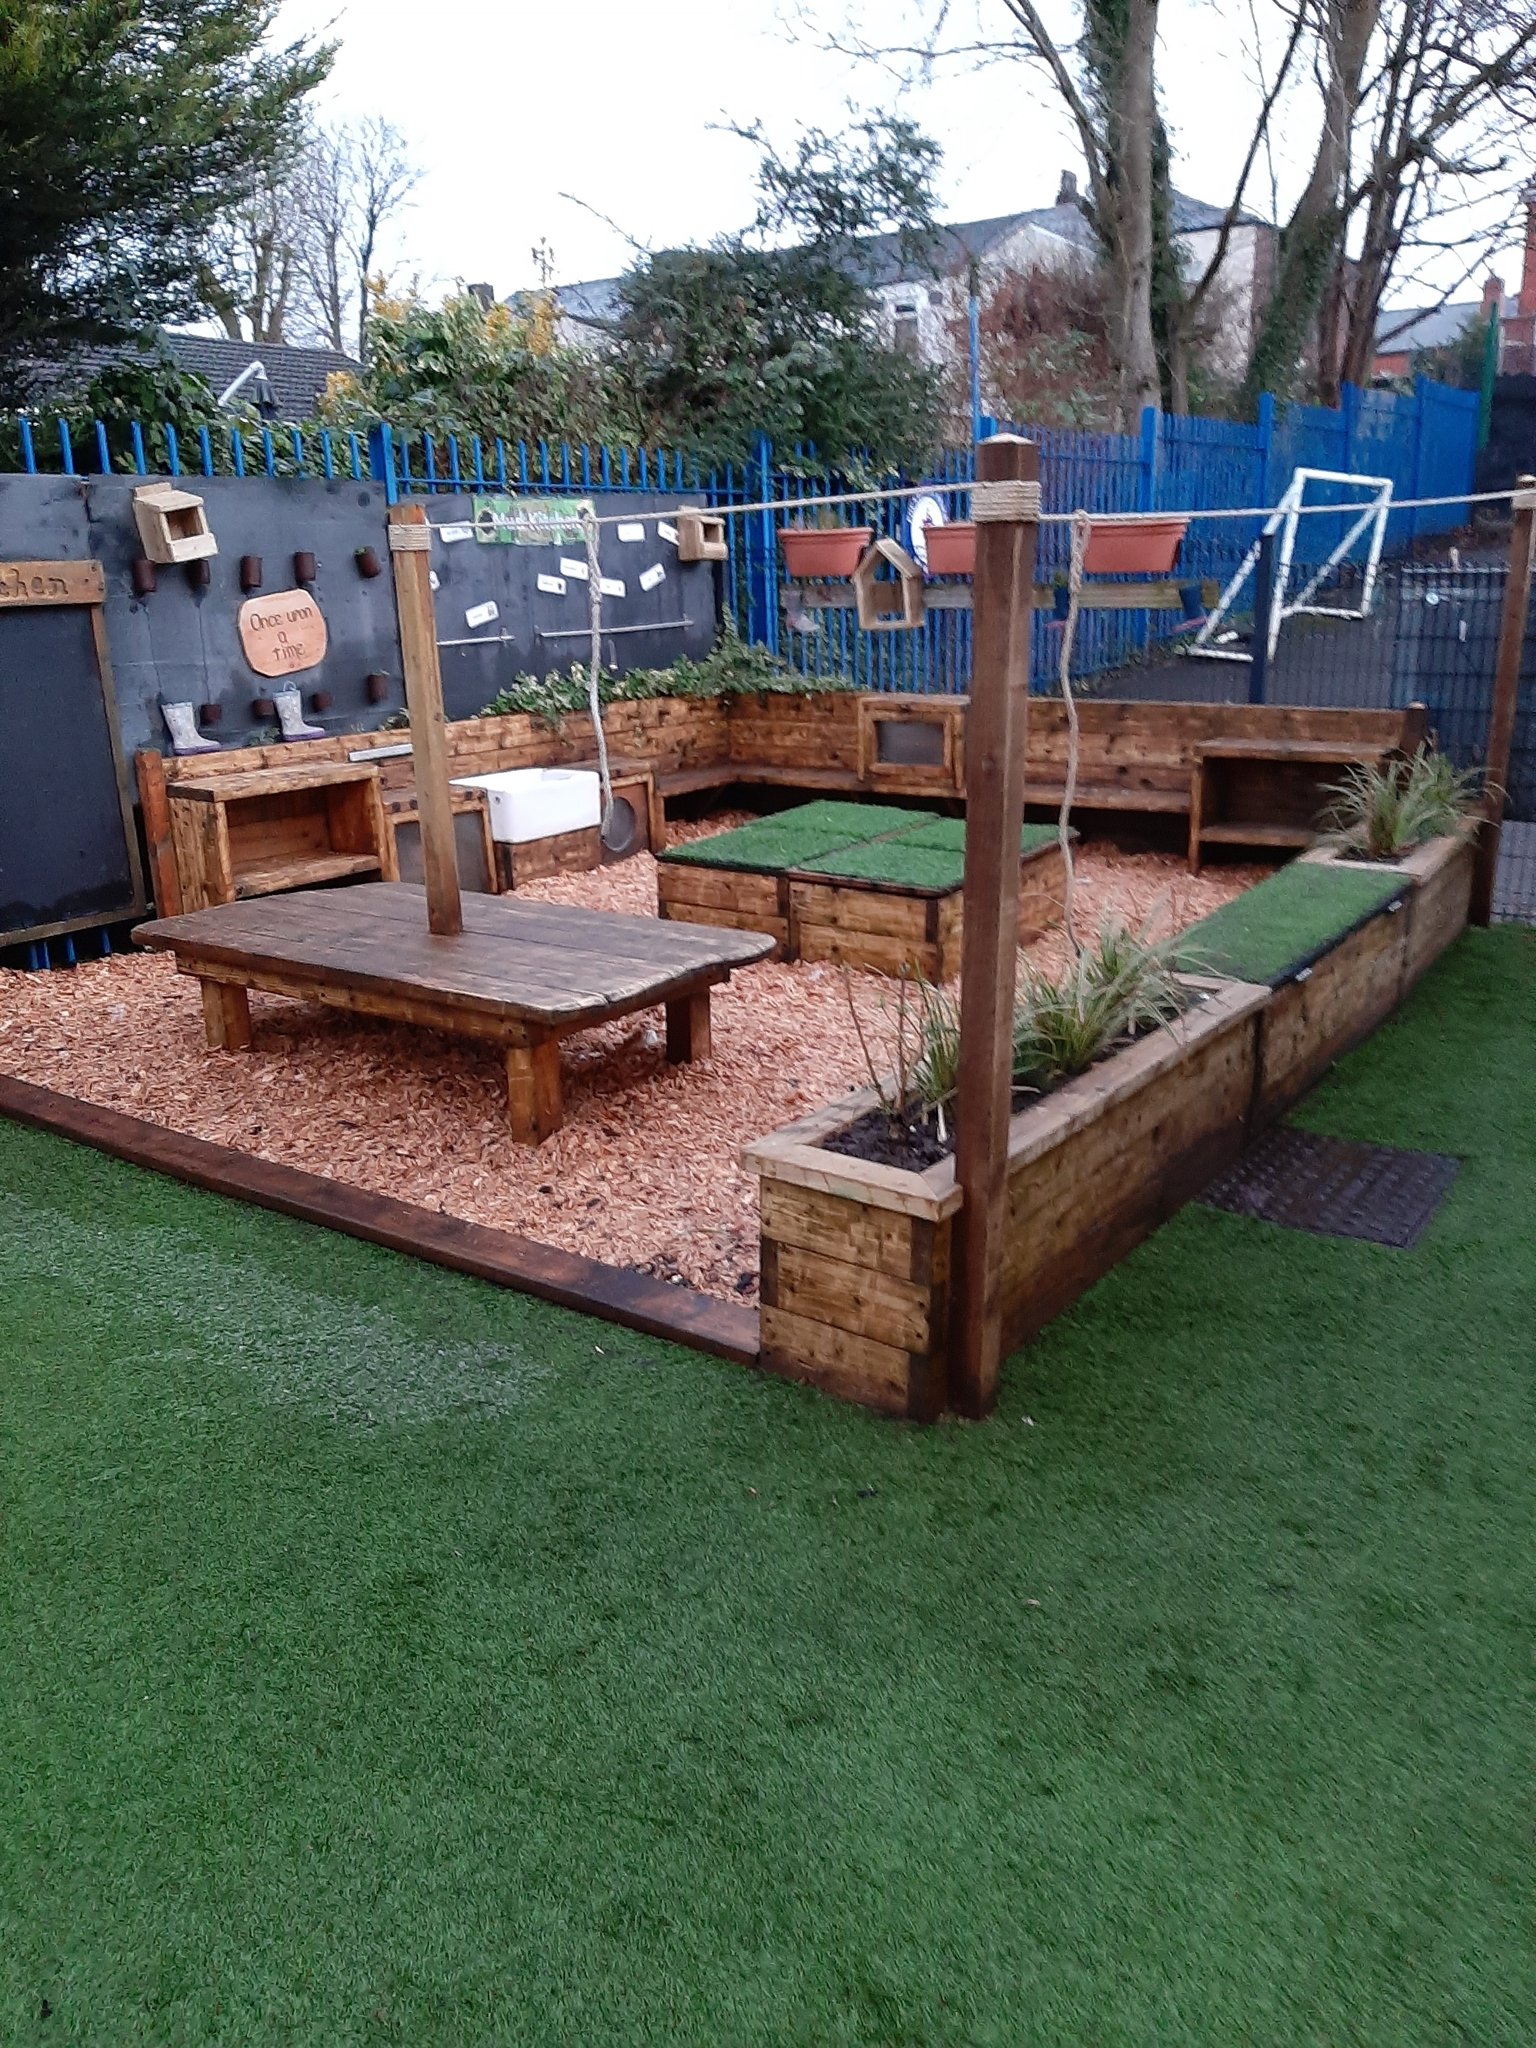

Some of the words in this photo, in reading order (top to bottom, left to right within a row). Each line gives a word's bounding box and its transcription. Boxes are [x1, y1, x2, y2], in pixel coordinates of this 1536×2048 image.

[250, 613, 282, 631] Once
[286, 606, 314, 623] upon
[277, 631, 288, 643] a
[272, 643, 306, 661] time
